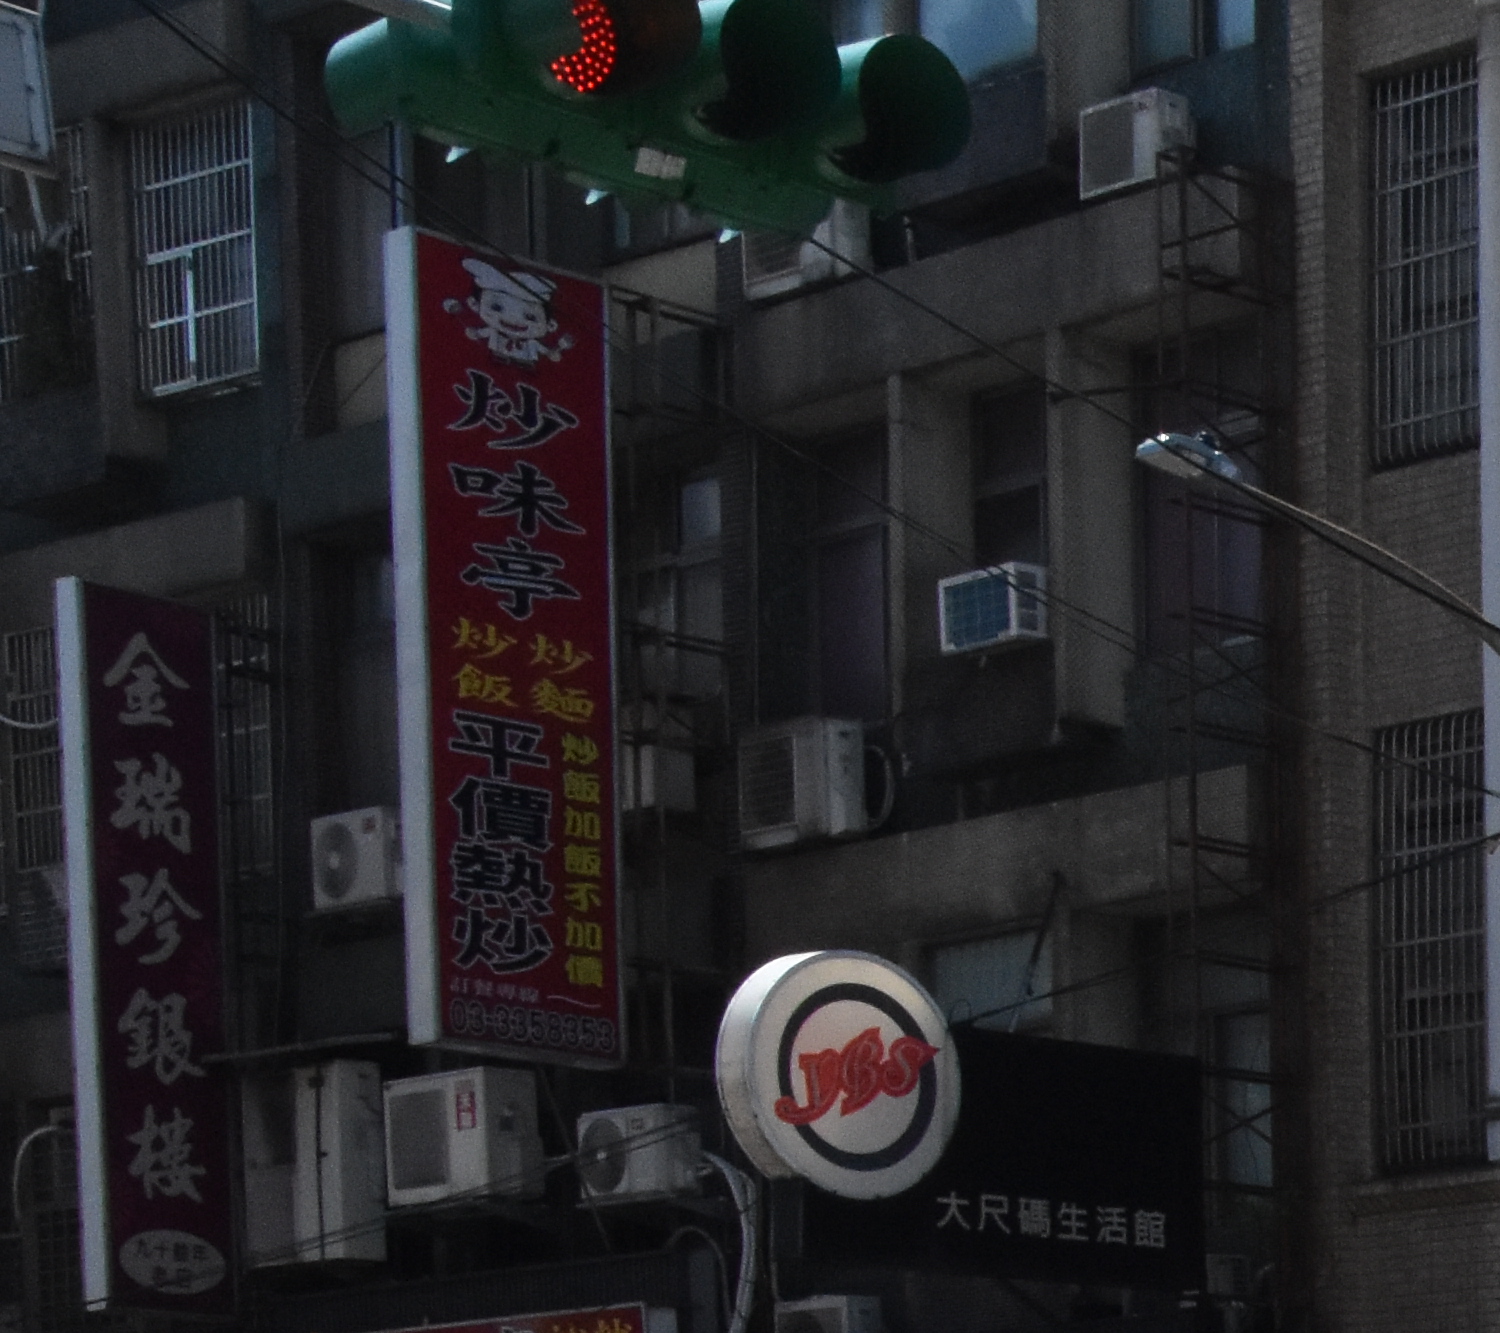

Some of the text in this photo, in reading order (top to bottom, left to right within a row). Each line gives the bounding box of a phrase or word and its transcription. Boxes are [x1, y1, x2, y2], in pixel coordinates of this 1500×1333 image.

[447, 369, 587, 621] 炒味亭
[102, 631, 207, 1201] 金瑞珍銀樓
[448, 708, 555, 975] 平價熱炒
[935, 1191, 1167, 1250] 大尺碼生活館
